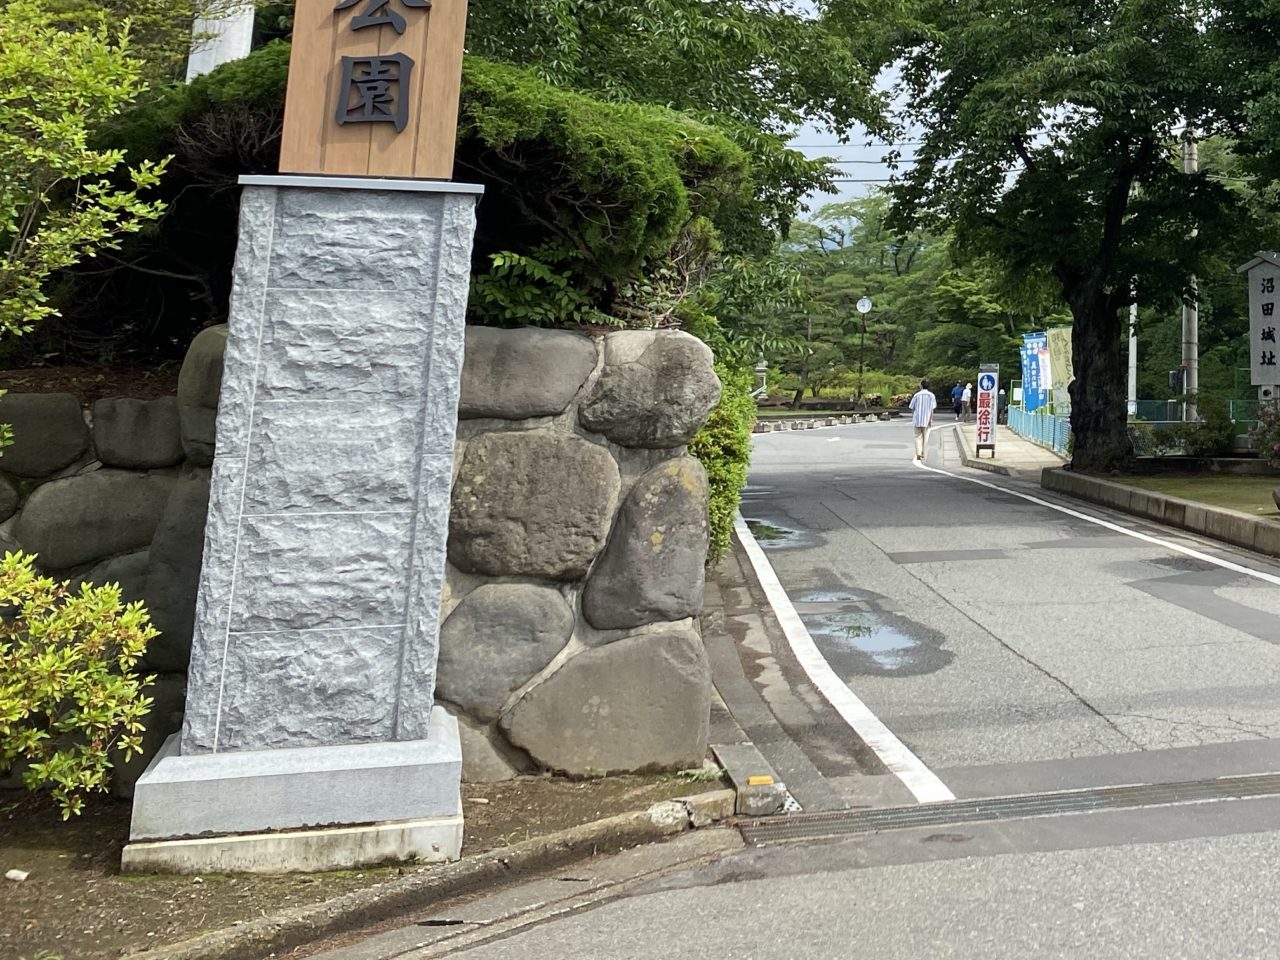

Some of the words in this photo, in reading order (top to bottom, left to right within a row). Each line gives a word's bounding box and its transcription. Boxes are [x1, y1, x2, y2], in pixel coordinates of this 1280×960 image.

[1259, 276, 1277, 367] 沼田城址
[978, 392, 991, 443] 最徐行
